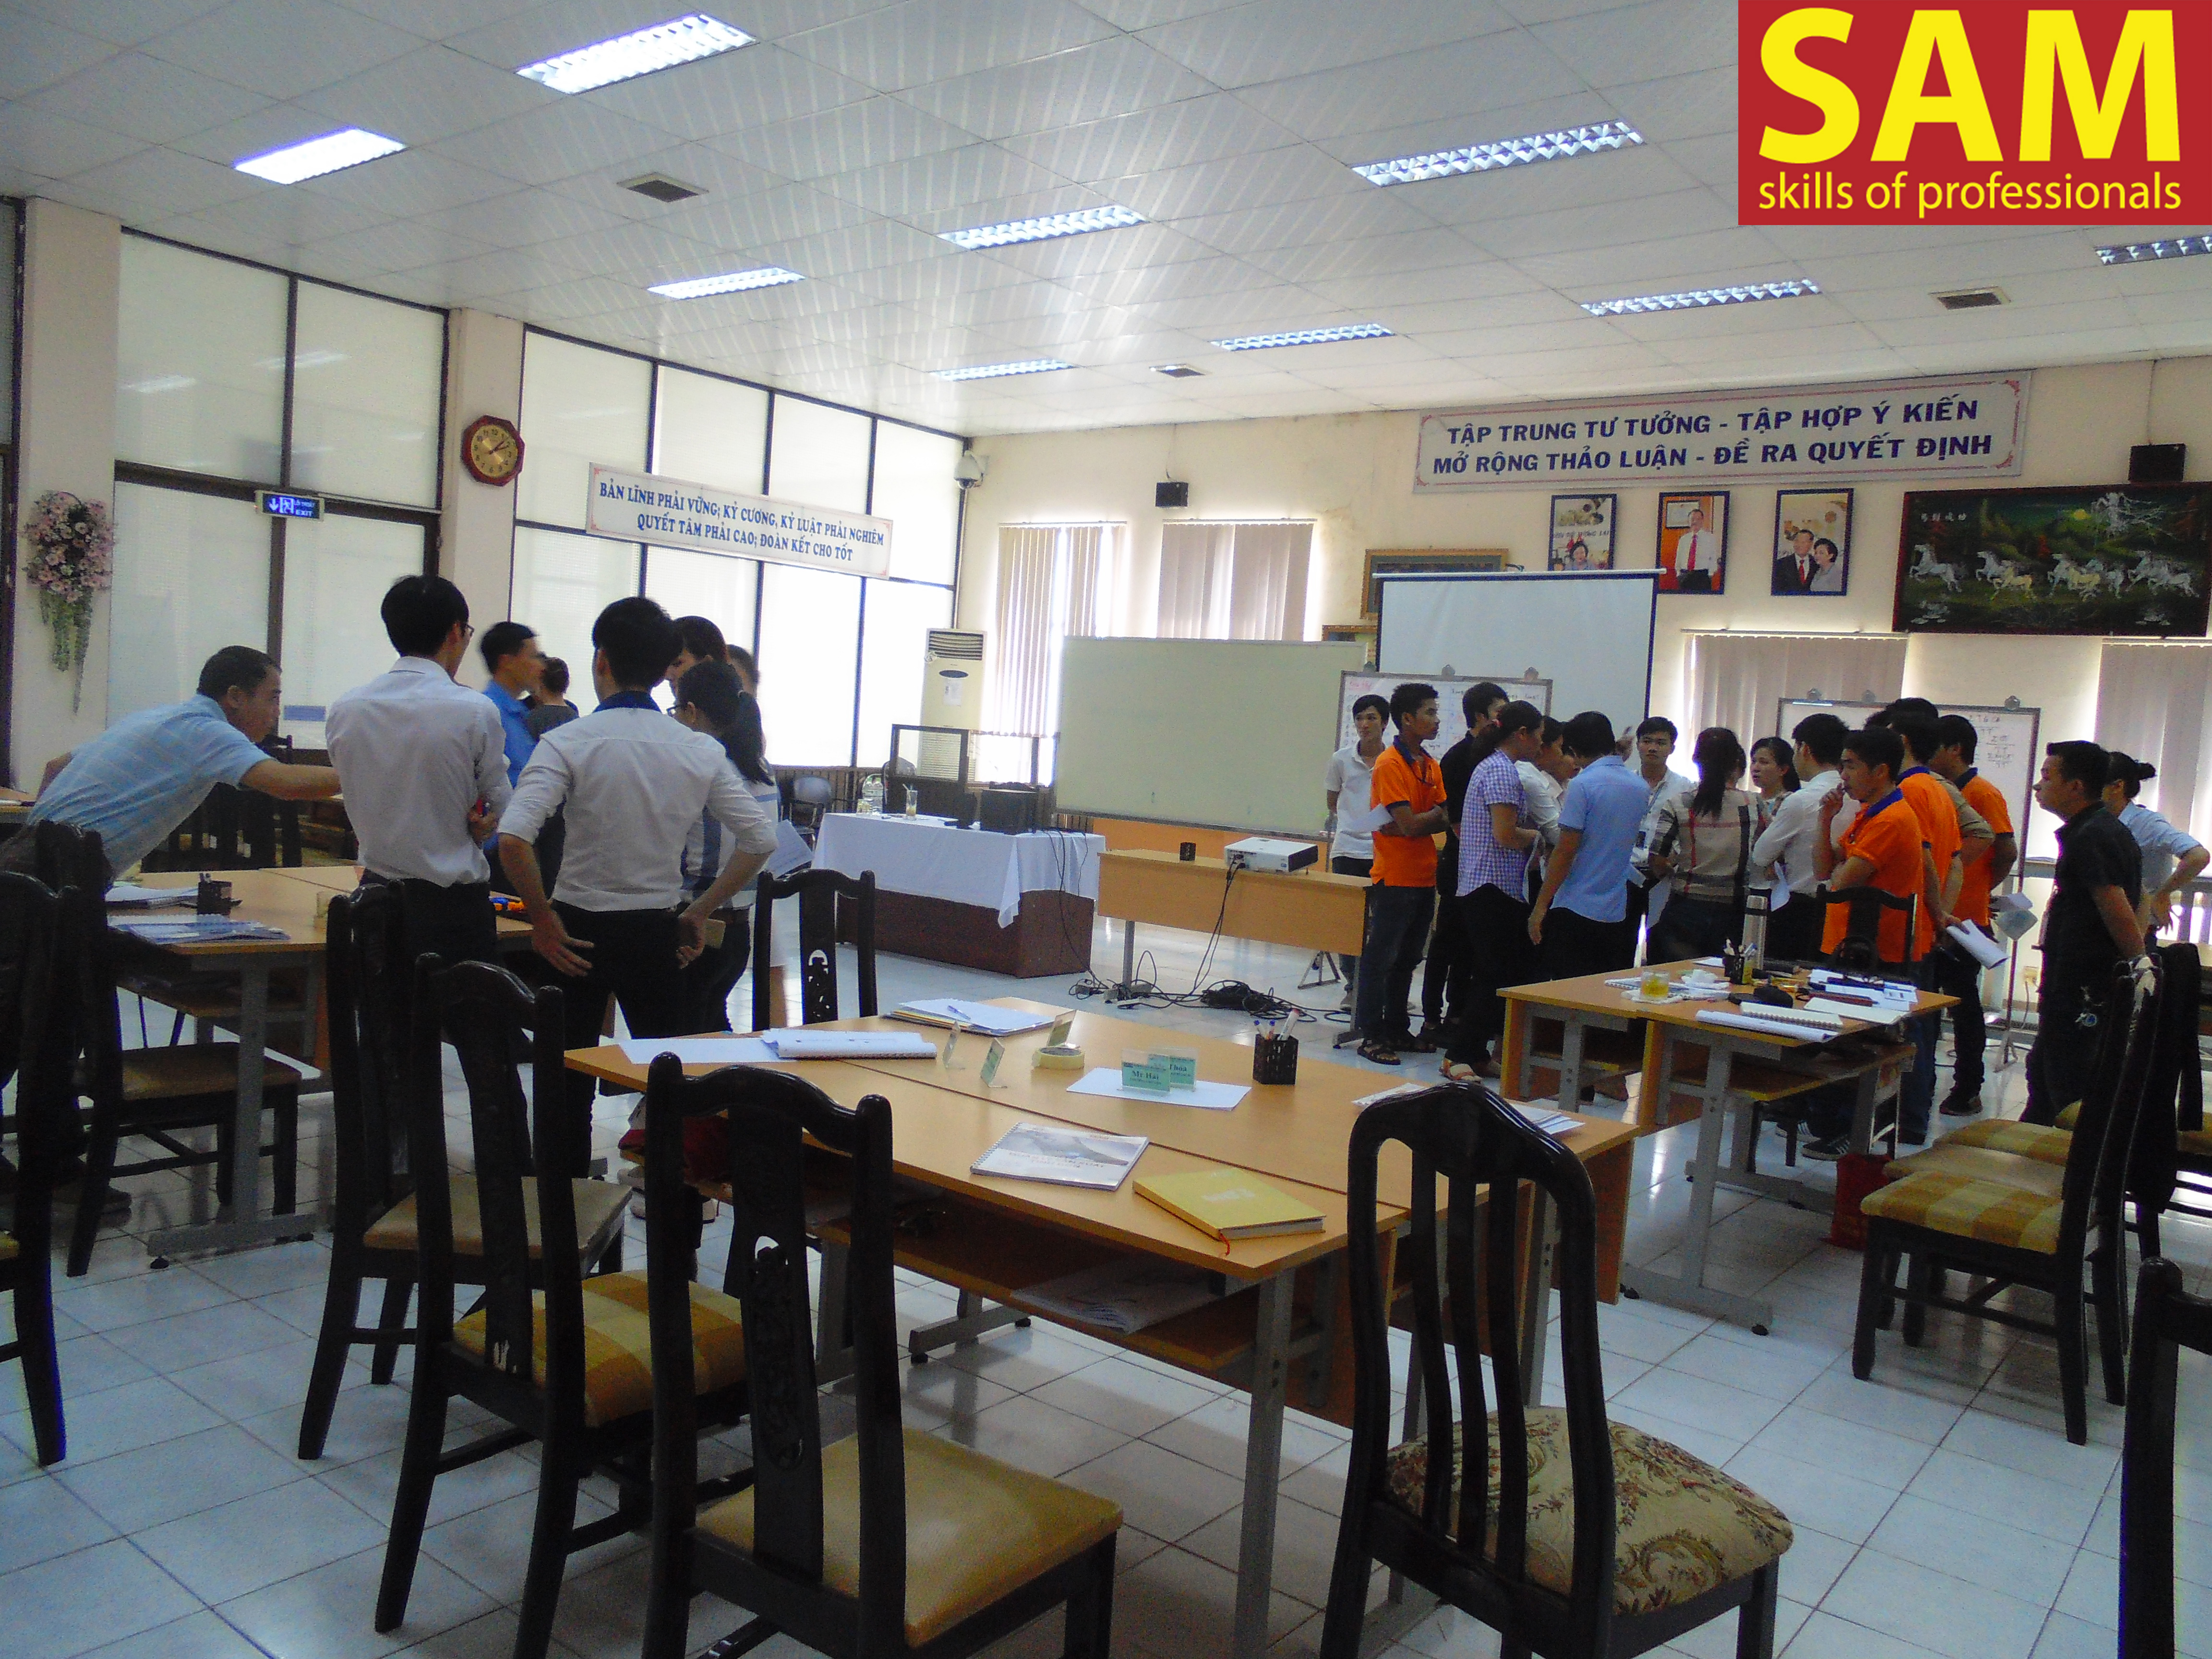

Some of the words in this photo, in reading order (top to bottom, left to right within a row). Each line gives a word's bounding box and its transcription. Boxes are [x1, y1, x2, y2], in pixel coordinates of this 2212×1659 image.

[1447, 423, 1491, 447] TẬP
[1499, 422, 1576, 442] TRUNG
[1585, 416, 1619, 437] TƯ
[1624, 410, 1710, 437] TƯỞNG
[1737, 407, 1792, 434] TẬP
[1802, 405, 1862, 432] HỢP
[1873, 400, 1891, 424] Ý
[1903, 393, 1978, 422] KIẾN
[1434, 450, 1467, 474] MỞ
[1476, 451, 1538, 475] RỘNG
[1546, 445, 1611, 470] THẢO
[1620, 445, 1686, 470] LUẬN
[1714, 437, 1750, 465] ĐỀ
[1761, 444, 1797, 463] RA
[1808, 432, 1905, 464] QUYẾT
[1916, 434, 1992, 461] ĐỊNH
[296, 509, 313, 517] EXIT
[600, 478, 624, 500] BẢN
[627, 484, 654, 505] LĨNH
[658, 490, 684, 510] PHẢI
[687, 496, 721, 520] VỮNG;
[723, 501, 738, 519] KỶ
[741, 507, 778, 529] CƯƠNG,
[781, 511, 795, 529] KỶ
[797, 517, 822, 537] LUẬT
[825, 520, 847, 539] PHẢI
[849, 529, 884, 546] NGHIÊM
[637, 512, 675, 531] QUYẾT
[678, 517, 702, 537] TÂM
[705, 521, 731, 541] PHẢI
[733, 529, 757, 549] CAO;
[760, 532, 789, 550] ĐOÀN
[791, 535, 810, 554] KẾT
[813, 543, 832, 557] CHO
[835, 542, 853, 561] TỐT
